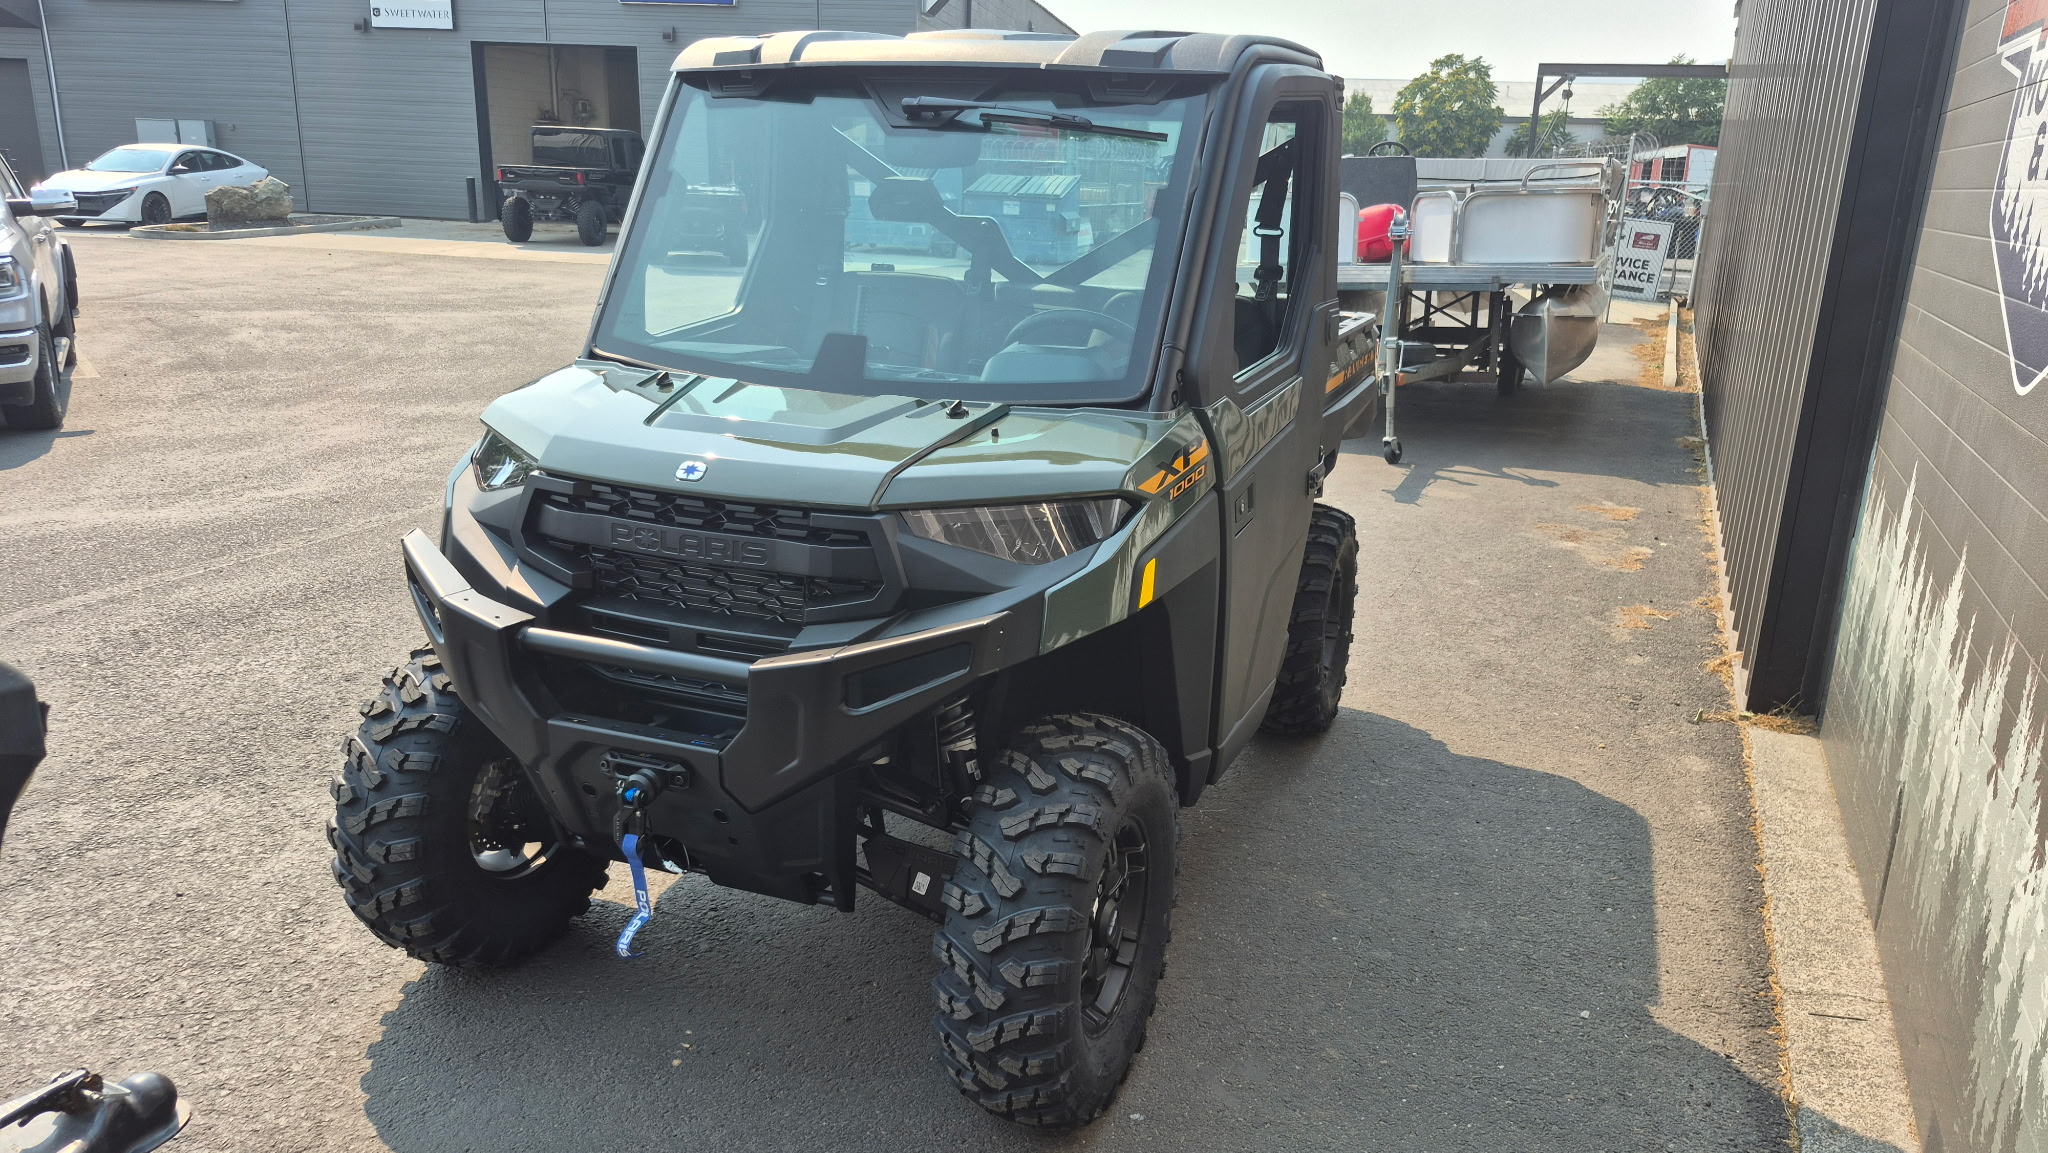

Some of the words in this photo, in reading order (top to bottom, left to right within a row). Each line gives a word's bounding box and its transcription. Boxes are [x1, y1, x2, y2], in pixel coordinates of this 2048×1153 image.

[384, 8, 450, 19] SWEETWATER
[1155, 435, 1205, 491] XP
[1169, 464, 1205, 501] 1000
[611, 522, 768, 566] POLARIS
[619, 889, 649, 957] POLARIS
